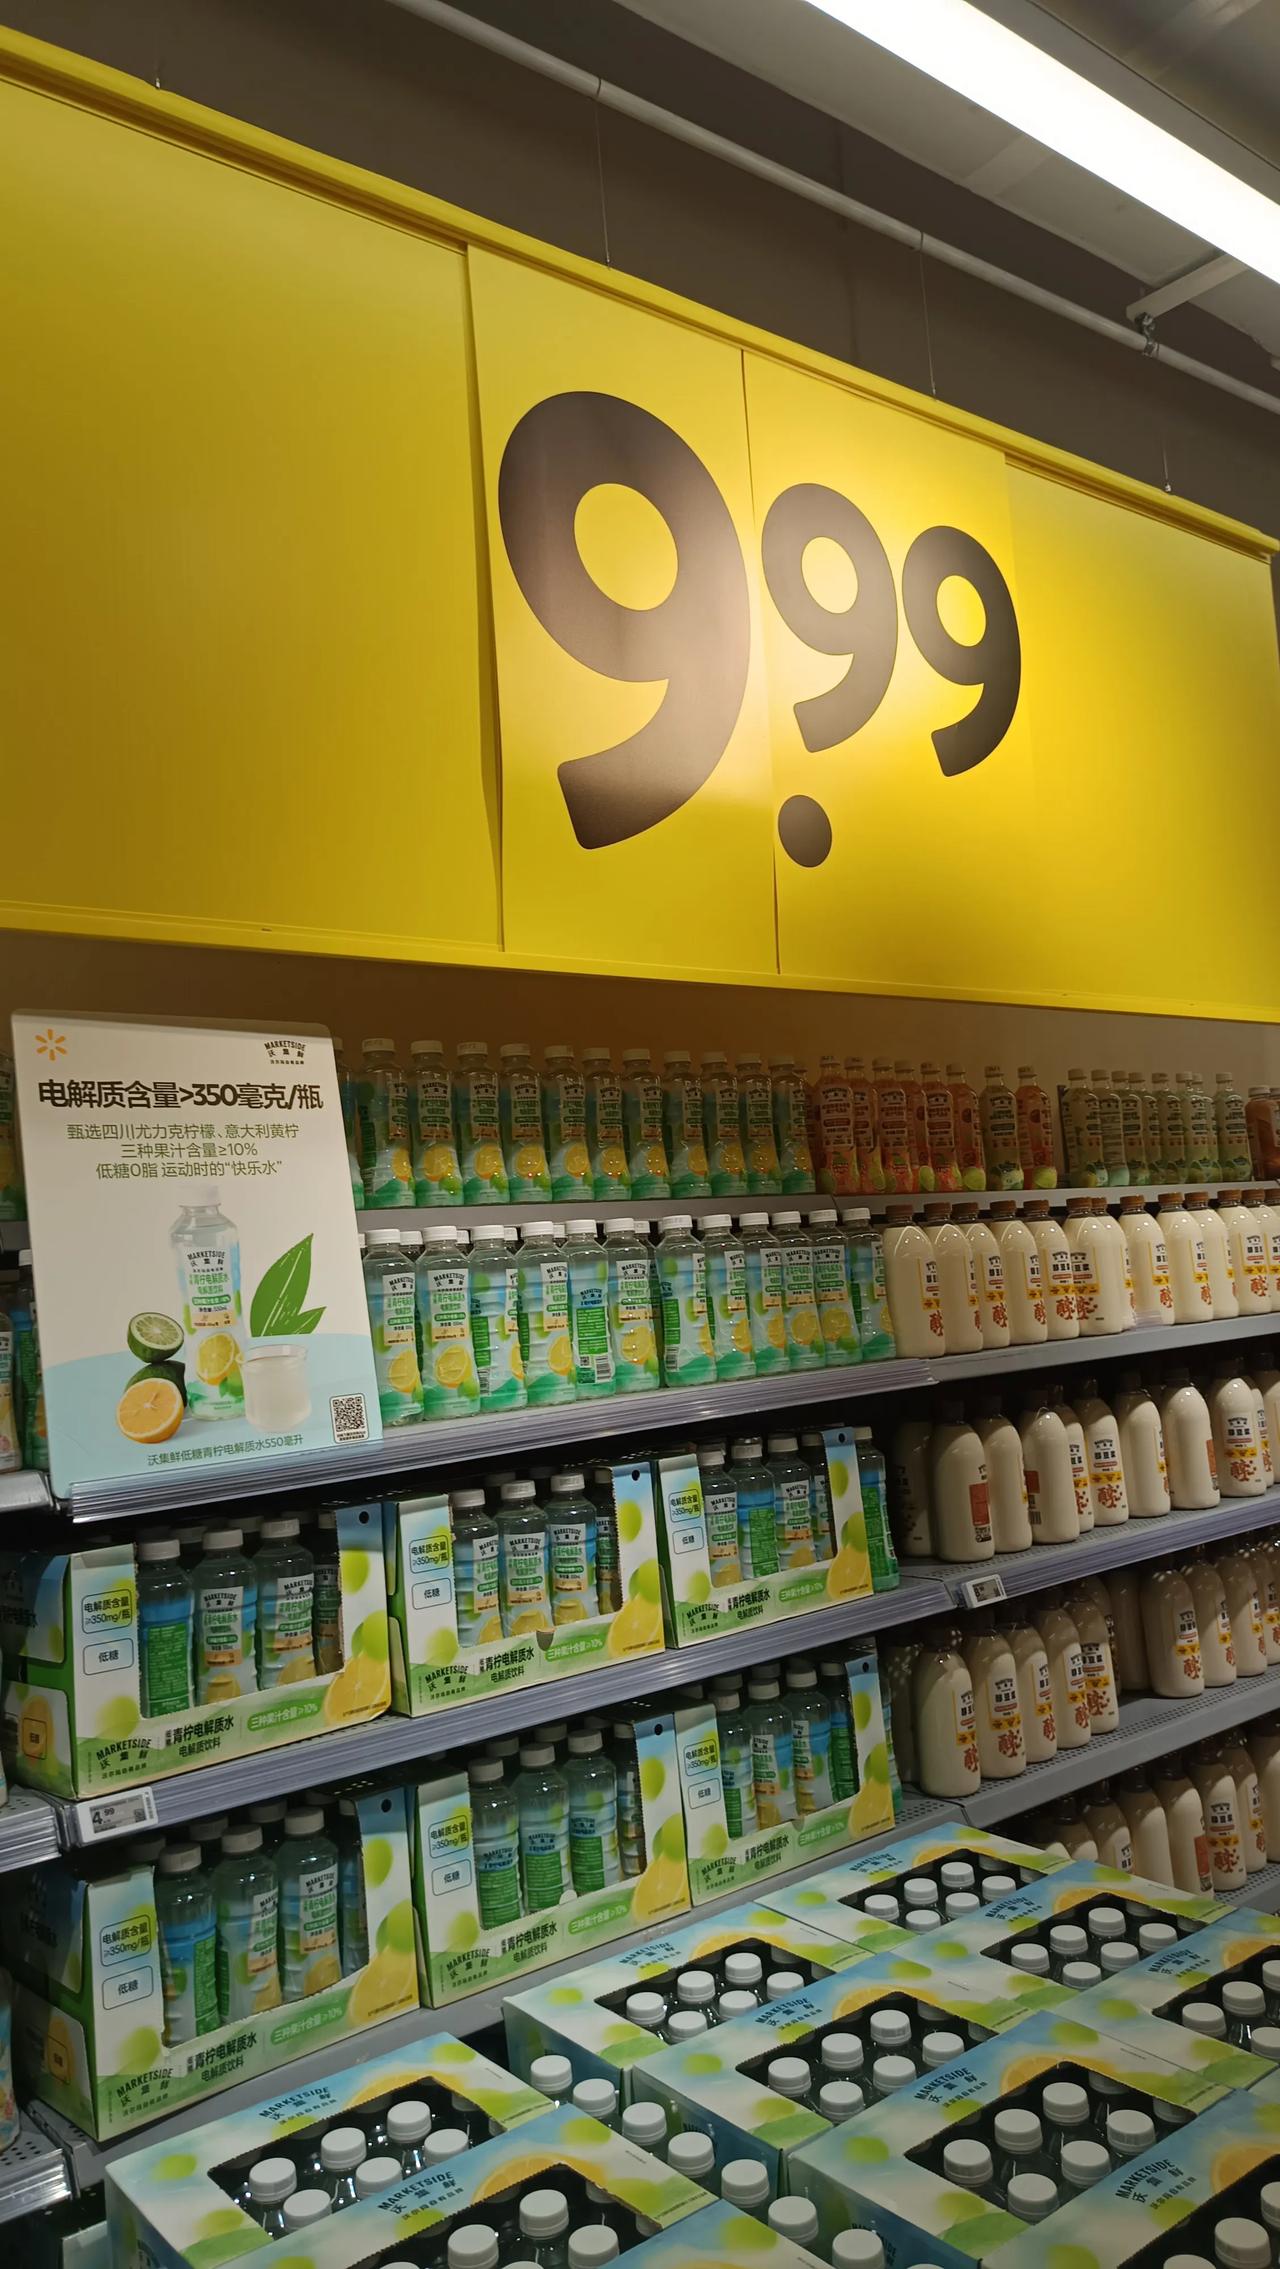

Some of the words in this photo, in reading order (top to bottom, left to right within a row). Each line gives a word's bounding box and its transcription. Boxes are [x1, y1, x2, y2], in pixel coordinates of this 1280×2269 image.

[498, 391, 1021, 868] 9.99
[264, 1040, 306, 1051] MARKETSIDE
[67, 1124, 299, 1141] 甄选四川尤力克柠檬、意大利黄柠
[121, 1143, 258, 1158] 三种果汁含量≥10%
[96, 1162, 158, 1179] 低糖0脂
[147, 1434, 304, 1466] 沃集鲜低糖青柠电解质水550毫升
[425, 1665, 468, 1683] MARKETSIDE
[173, 1714, 234, 1744] 青柠电解质水
[96, 1738, 152, 1760] MARKETSIDE
[194, 2032, 257, 2070] 青柠电解质水
[116, 2068, 173, 2098] MARKETSIDE
[914, 2066, 971, 2101] MARKETSIDE
[258, 2087, 329, 2117] MARKETSIDE
[377, 2171, 454, 2210] MARKETSIDE
[1115, 2158, 1174, 2200] MARKETSIDE
